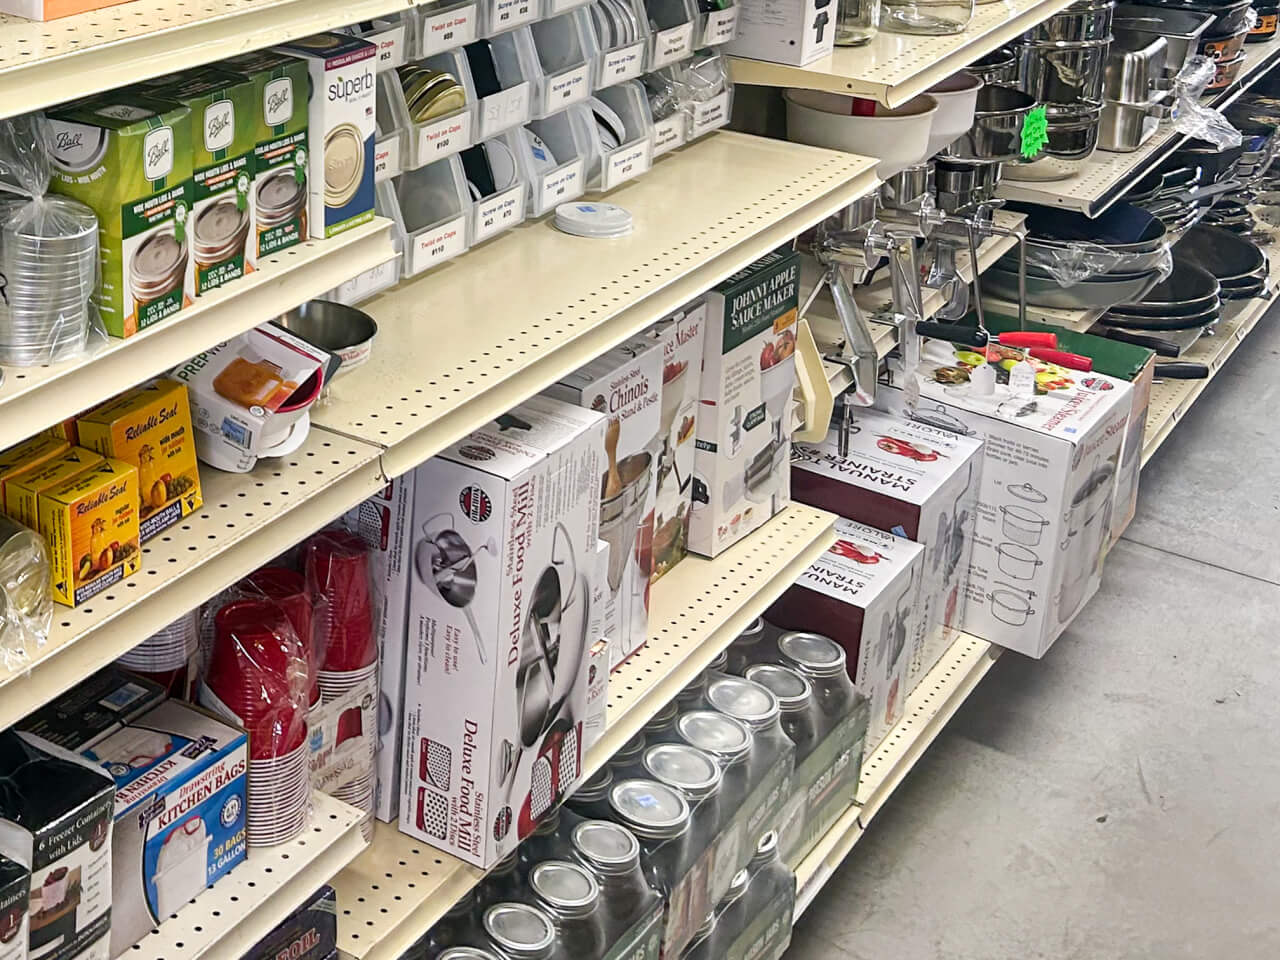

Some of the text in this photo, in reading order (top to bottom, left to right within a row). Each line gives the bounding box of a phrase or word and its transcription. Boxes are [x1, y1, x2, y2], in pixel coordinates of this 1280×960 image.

[268, 87, 288, 112] Ball
[56, 131, 82, 152] Ball
[208, 112, 230, 138] Ball
[148, 139, 169, 169] Ball
[421, 239, 435, 248] Twist
[444, 231, 456, 240] Caps
[731, 266, 796, 317] JOHNNY APPLE
[731, 283, 794, 329] SAUCE MAKER
[609, 375, 649, 413] Chinois
[125, 404, 178, 441] Reliable Seal
[825, 454, 917, 485] STRAINER
[829, 462, 910, 491] MANUAL
[77, 482, 126, 516] Reliable Seal
[470, 486, 482, 522] NORPRO
[507, 481, 530, 667] Deluxe Food Mill
[158, 761, 245, 829] KITCHEN BAGS
[179, 760, 226, 799] Drawstring
[457, 719, 478, 852] Deluxe Food Mill
[472, 792, 483, 857] Stainless Steel
[208, 843, 246, 876] 13 GALLON
[213, 830, 246, 859] 30 BAGS
